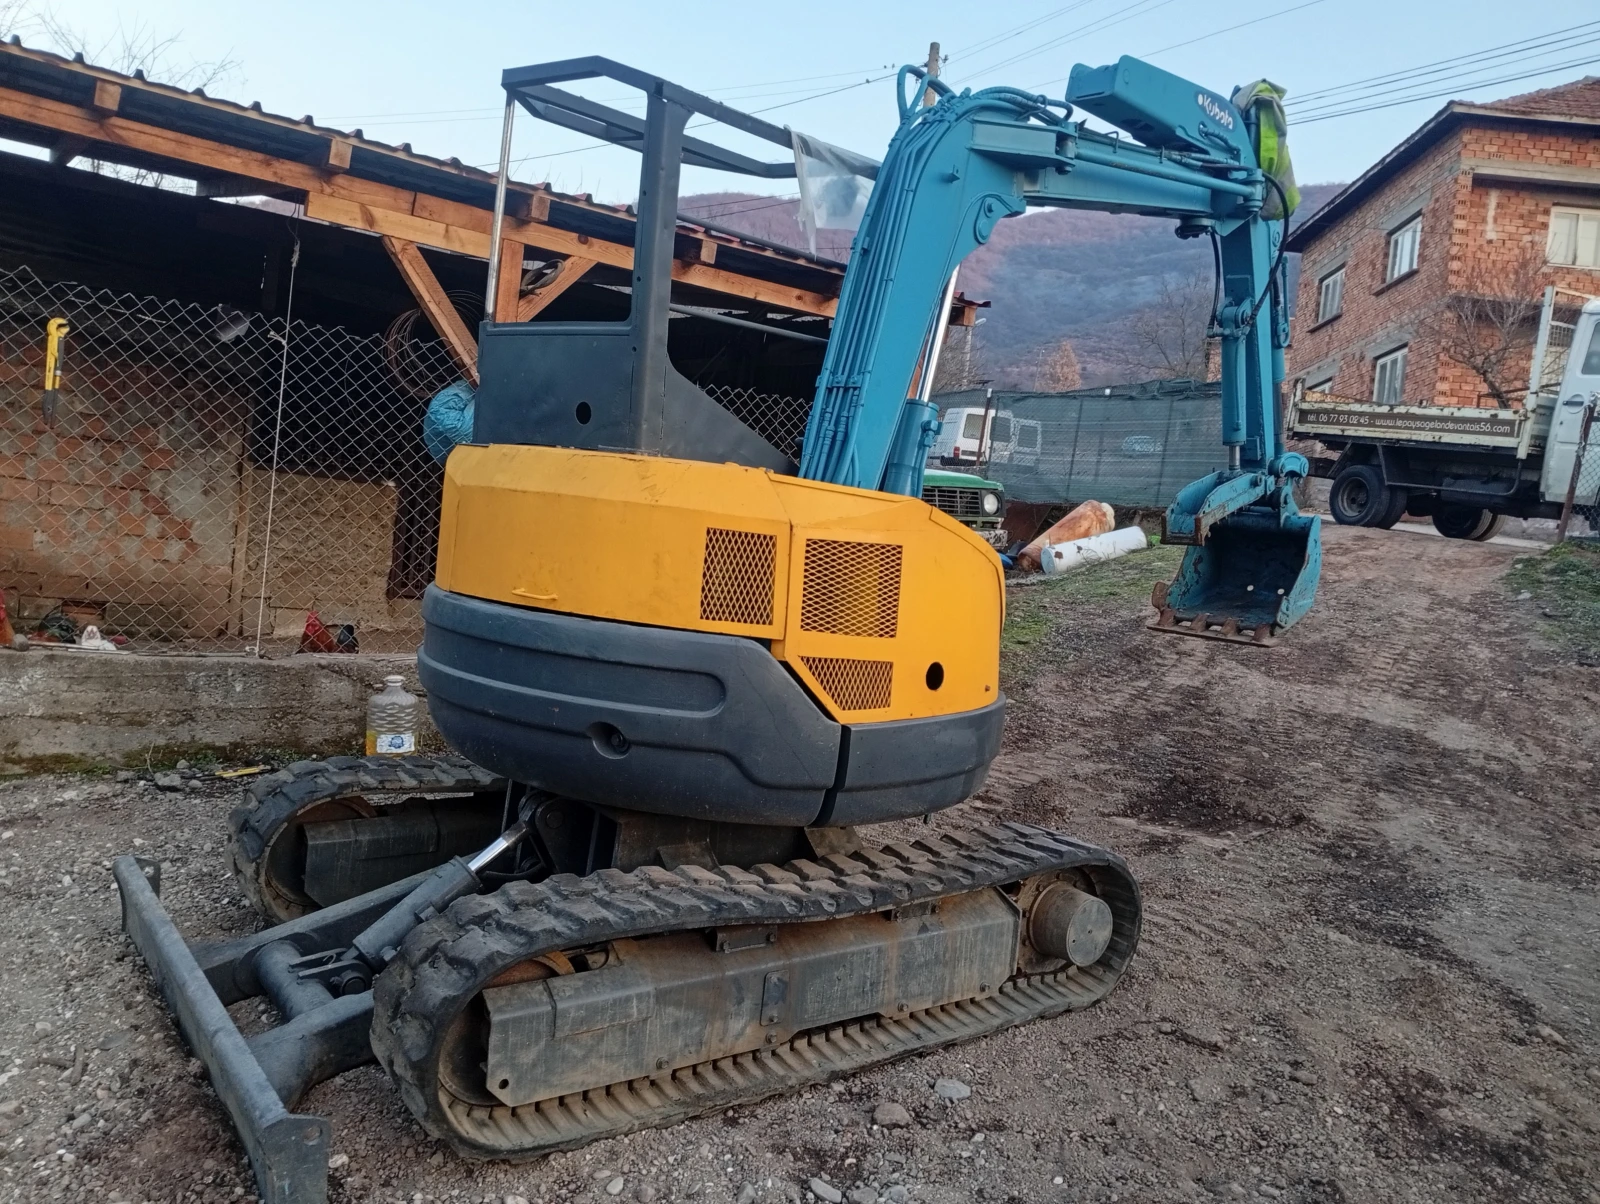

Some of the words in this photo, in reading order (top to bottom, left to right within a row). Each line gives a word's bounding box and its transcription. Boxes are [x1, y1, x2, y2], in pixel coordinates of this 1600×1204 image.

[1203, 94, 1233, 130] Kubota
[1319, 413, 1328, 422] 06
[1329, 414, 1338, 423] 77
[1339, 414, 1348, 424] 93
[1349, 415, 1359, 424] 02
[1359, 415, 1369, 425] 45
[1375, 417, 1511, 433] www.lepaysagelandevantais56.com
